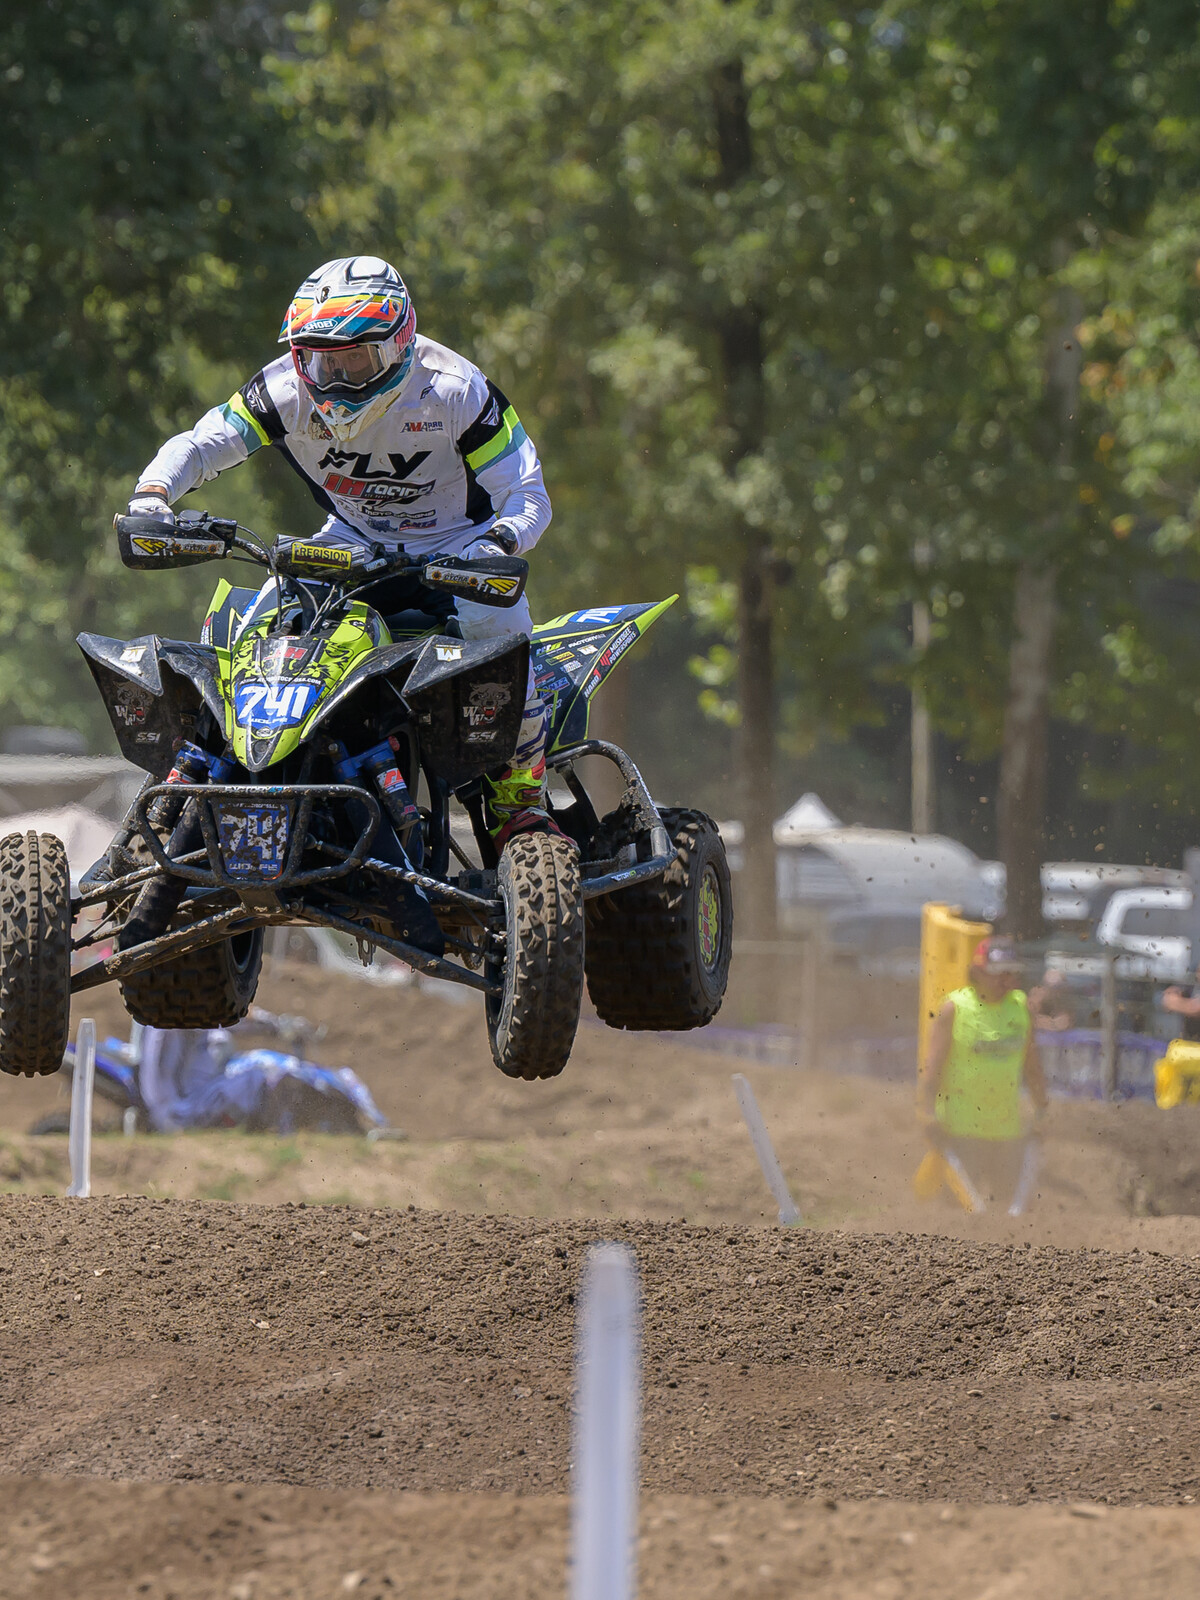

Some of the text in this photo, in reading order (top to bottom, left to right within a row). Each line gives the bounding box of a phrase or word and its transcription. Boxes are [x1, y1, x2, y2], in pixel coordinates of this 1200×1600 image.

[304, 319, 335, 332] SHOEI
[401, 421, 428, 433] AMA
[318, 447, 433, 480] FLY
[365, 483, 433, 498] racing
[238, 685, 310, 720] 741
[467, 731, 497, 743] SSI
[220, 814, 287, 860] 741
[228, 862, 278, 872] WOFE
